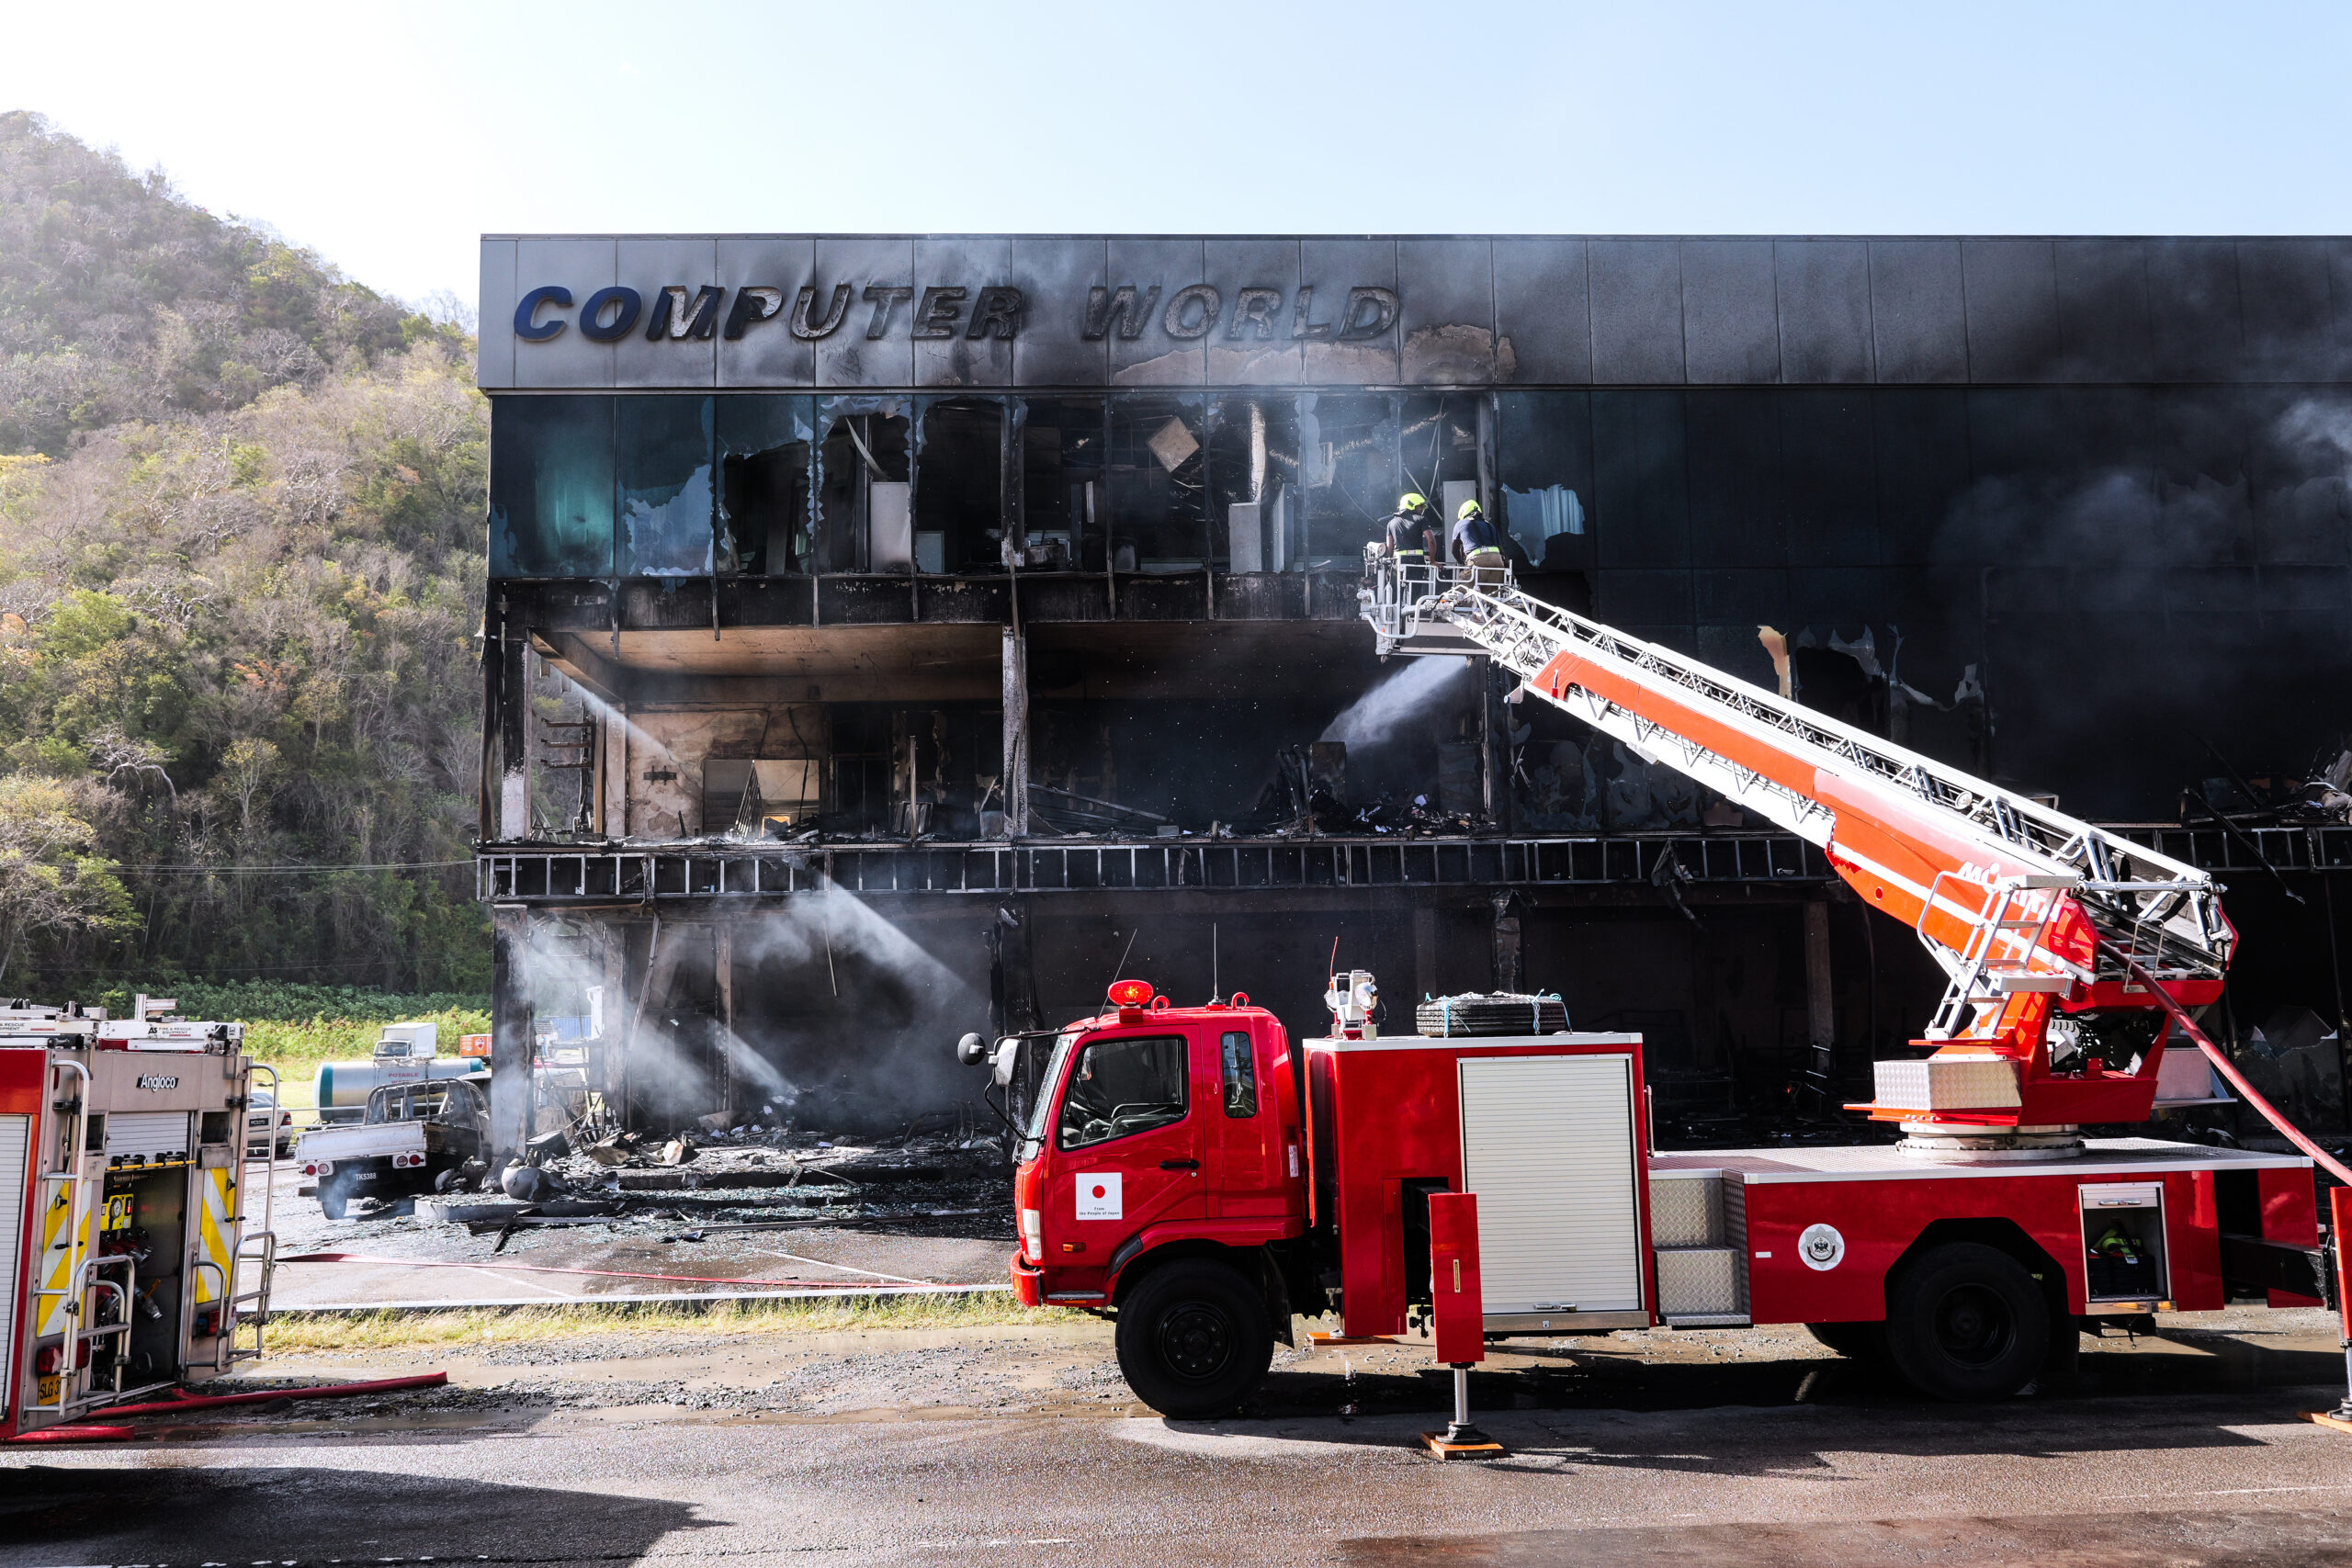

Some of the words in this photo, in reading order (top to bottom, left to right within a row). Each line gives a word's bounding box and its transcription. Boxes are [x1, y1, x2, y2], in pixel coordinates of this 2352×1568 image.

[514, 285, 1023, 343] COMPUTER
[1082, 284, 1399, 342] WORLD
[140, 1073, 176, 1091] Angloco
[39, 1382, 53, 1400] SLG
